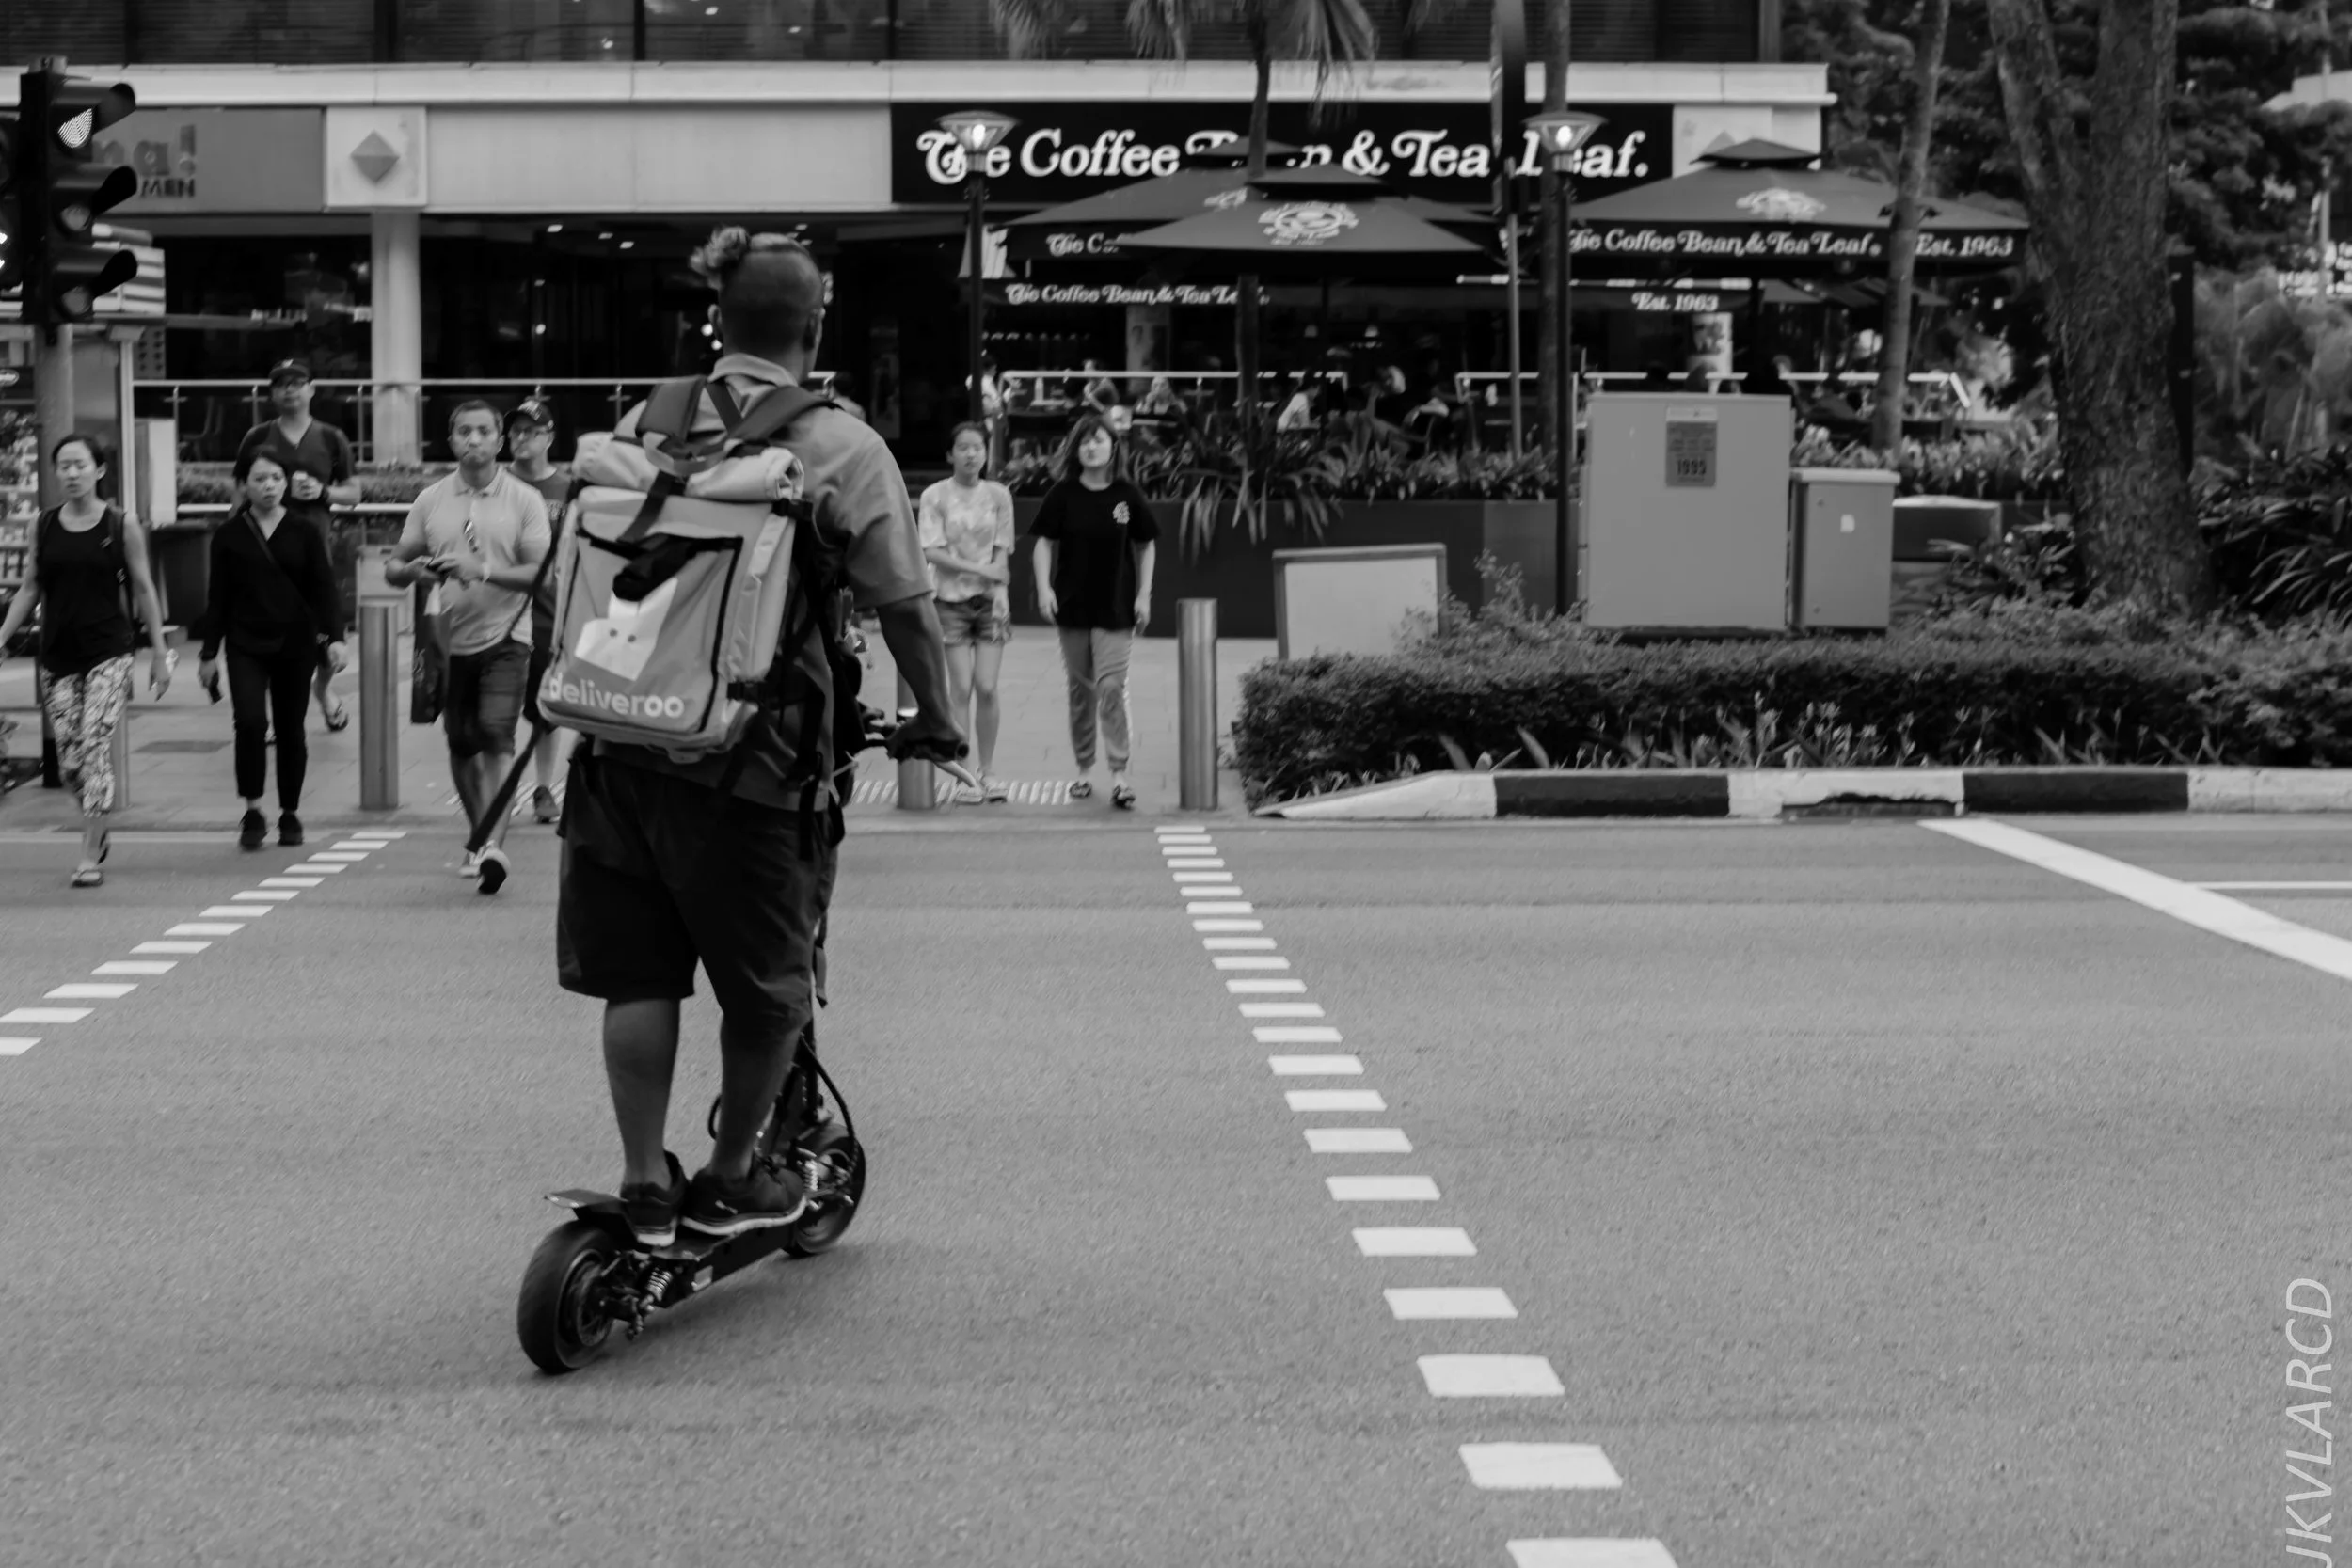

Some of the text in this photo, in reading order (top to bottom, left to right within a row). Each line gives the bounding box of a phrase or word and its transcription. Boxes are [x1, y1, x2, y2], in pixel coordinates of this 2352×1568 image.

[1020, 128, 1181, 177] Coffee
[1341, 129, 1391, 177] &
[1391, 128, 1491, 178] Tea
[1045, 232, 1085, 257] The
[1604, 229, 1676, 253] Coffee
[1766, 230, 1811, 255] Tea
[1958, 235, 2014, 258] 1963
[1004, 283, 1041, 306] The
[1041, 284, 1101, 304] Coffee
[1174, 285, 1212, 305] Tea
[1673, 293, 1720, 312] 1963
[548, 671, 686, 718] deliveroo
